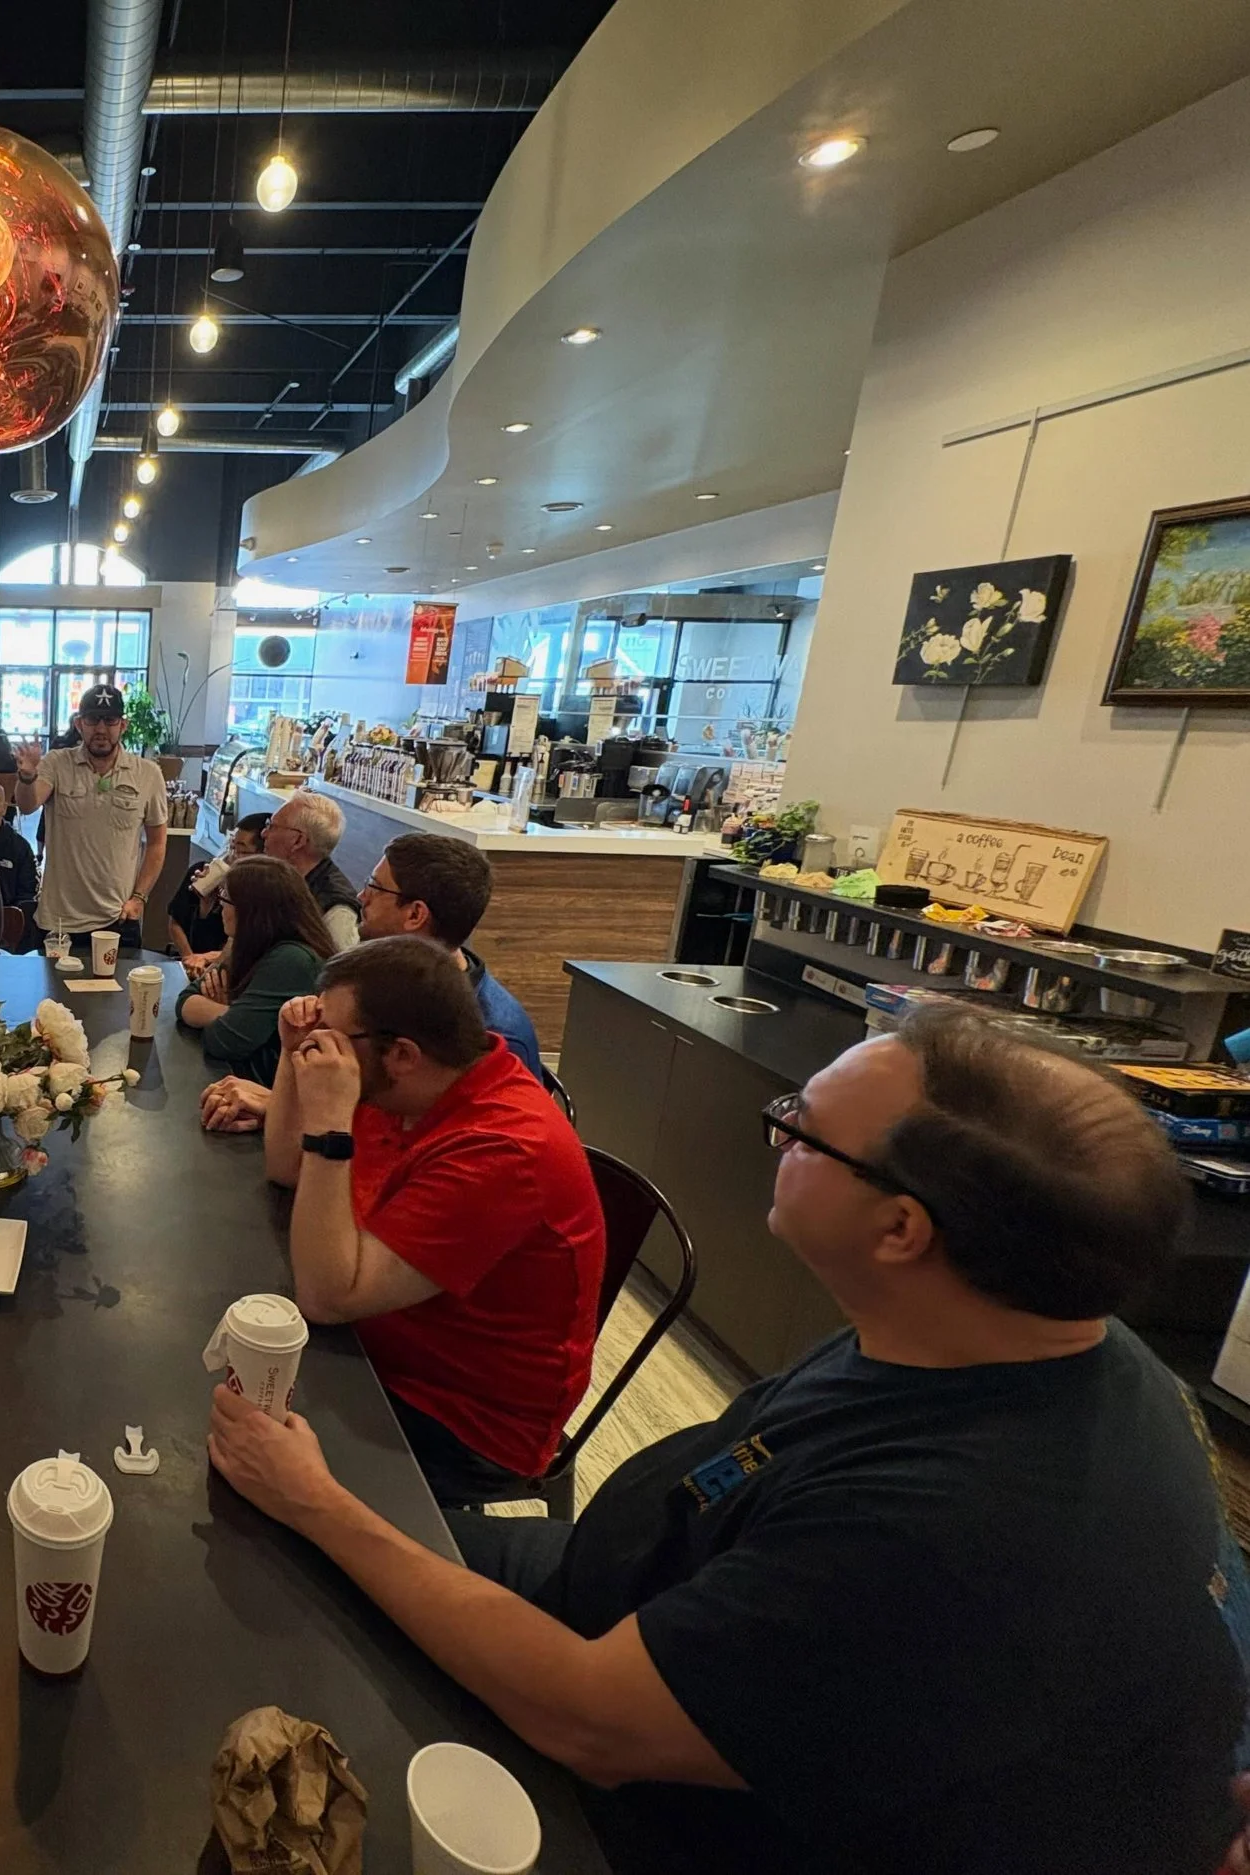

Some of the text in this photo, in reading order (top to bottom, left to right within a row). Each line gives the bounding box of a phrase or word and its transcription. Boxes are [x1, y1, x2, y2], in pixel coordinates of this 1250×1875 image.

[965, 833, 1003, 848] coffee
[1052, 846, 1084, 865] bean
[263, 1366, 280, 1416] SWEETW
